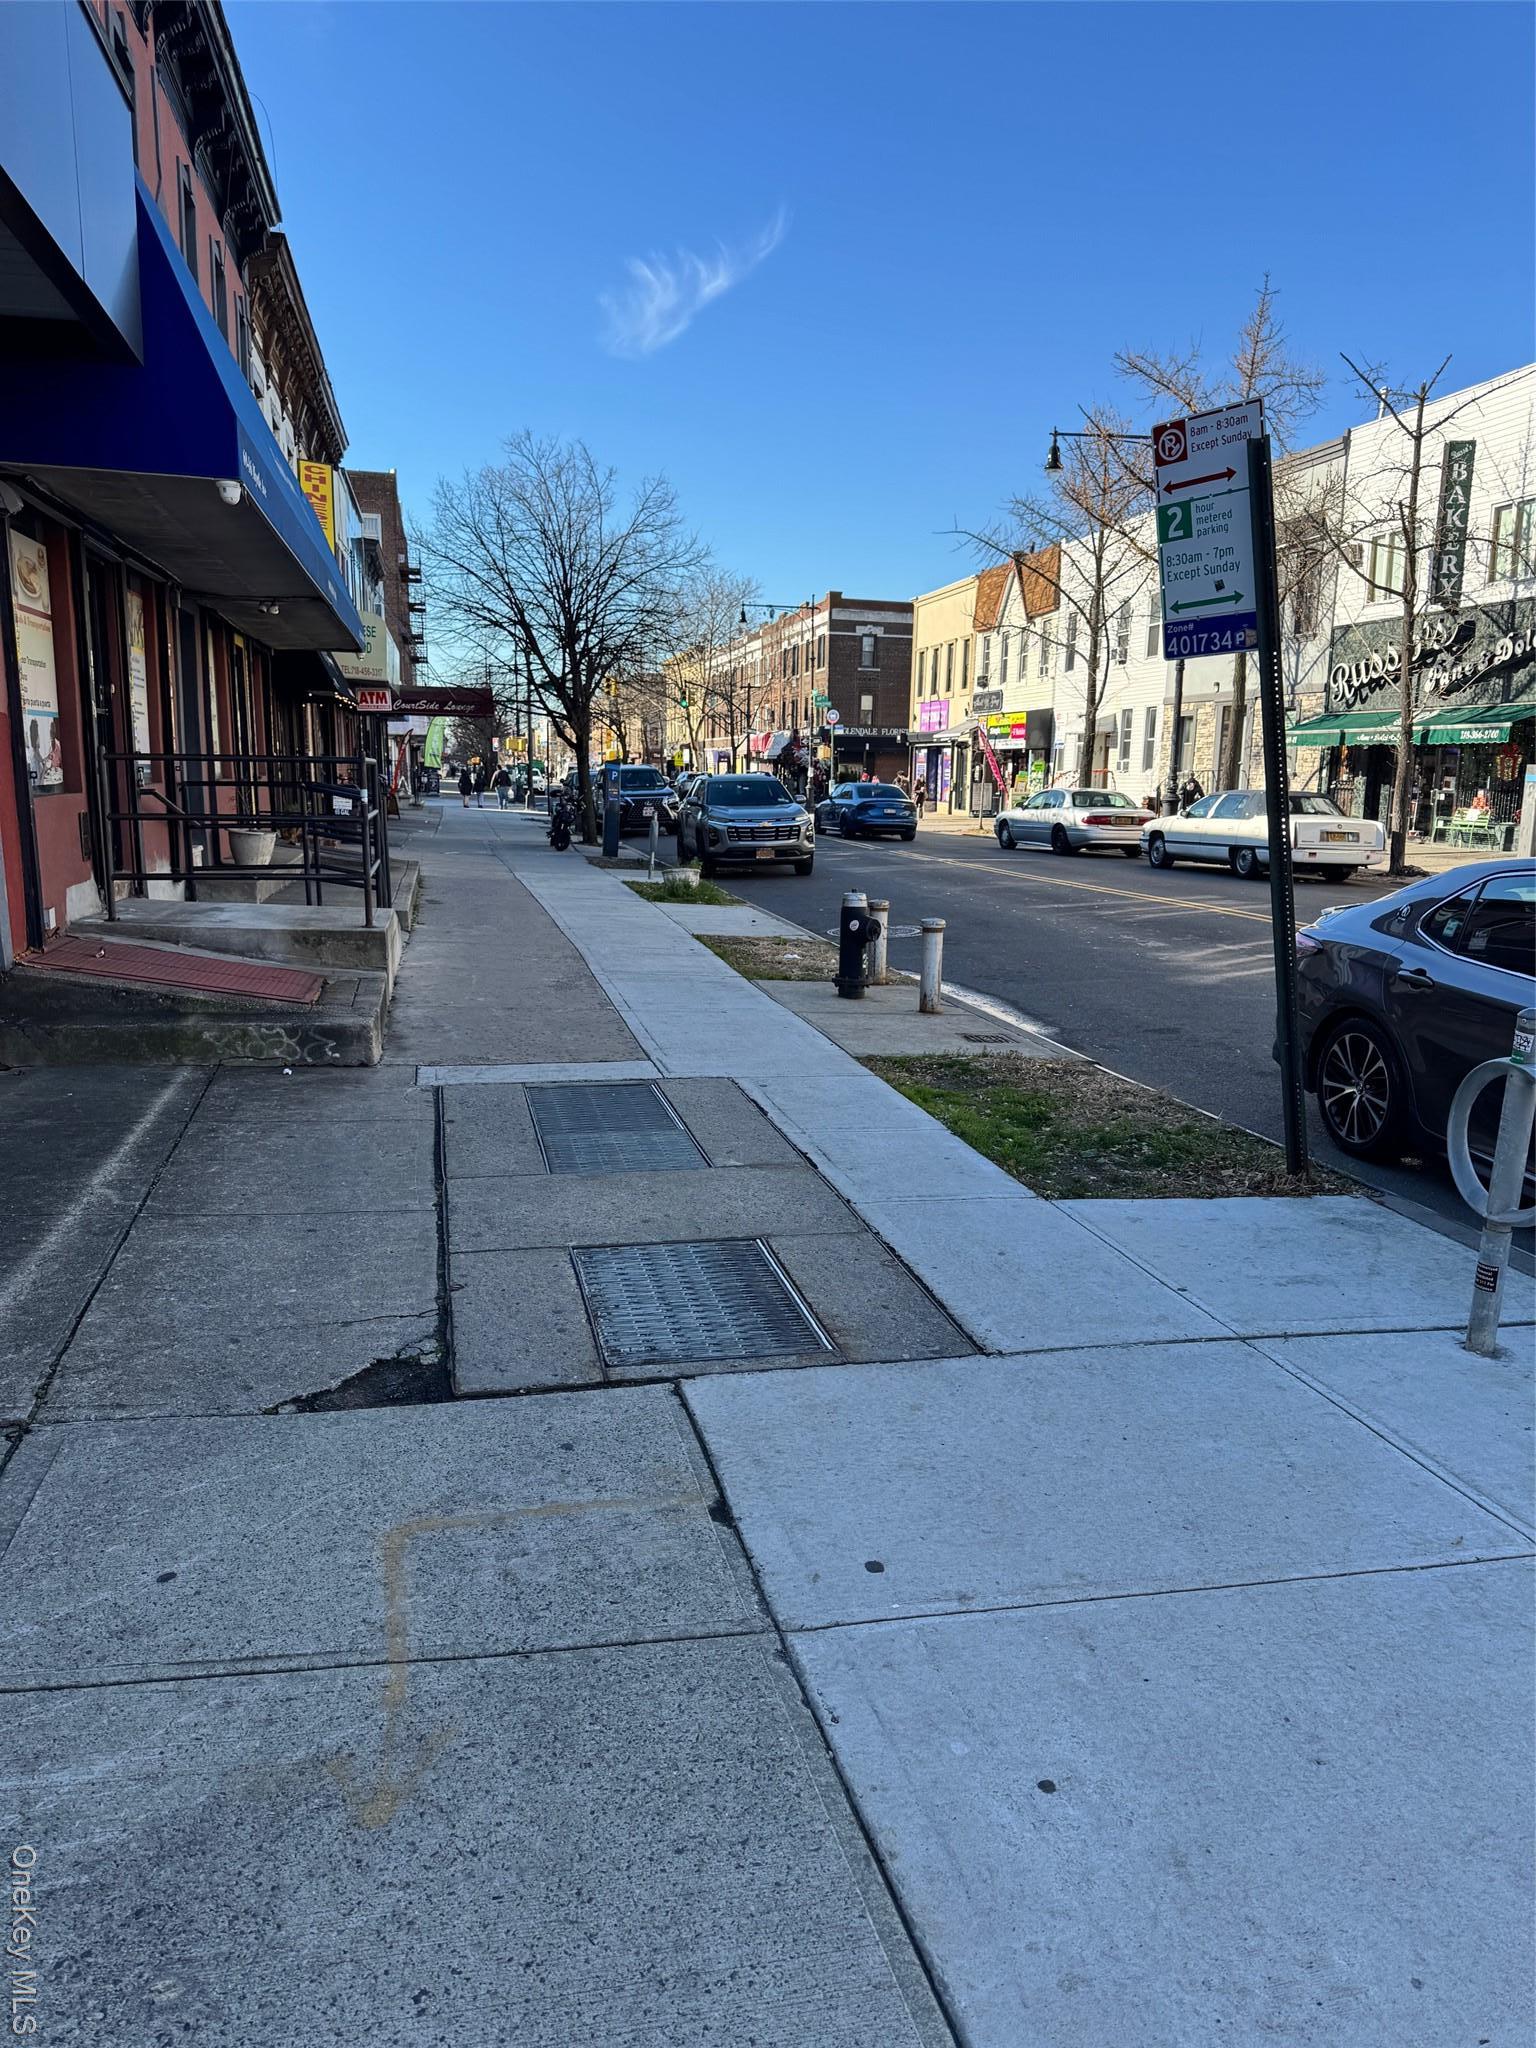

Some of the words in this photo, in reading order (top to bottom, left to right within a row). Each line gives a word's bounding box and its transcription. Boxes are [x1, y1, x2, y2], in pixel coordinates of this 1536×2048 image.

[1190, 425, 1208, 437] 8am
[1216, 415, 1248, 430] 8:30am
[1191, 437, 1219, 452] Except
[1221, 430, 1252, 445] Sunday
[1195, 502, 1215, 513] hour
[1196, 509, 1233, 525] metered
[1167, 506, 1184, 538] 2
[1197, 523, 1229, 538] parking
[1440, 462, 1468, 597] BAKERY
[1166, 552, 1203, 567] 8:30am
[1213, 546, 1234, 560] 7pm
[1167, 566, 1201, 582] Except
[1203, 560, 1241, 576] Sunday
[1167, 623, 1194, 633] Zone#
[1167, 630, 1232, 655] 401734
[1493, 629, 1536, 665] Dol
[360, 691, 388, 704] ATM
[393, 700, 440, 711] CourtSide
[443, 701, 475, 713] Lounge
[844, 727, 878, 736] GLENDALE
